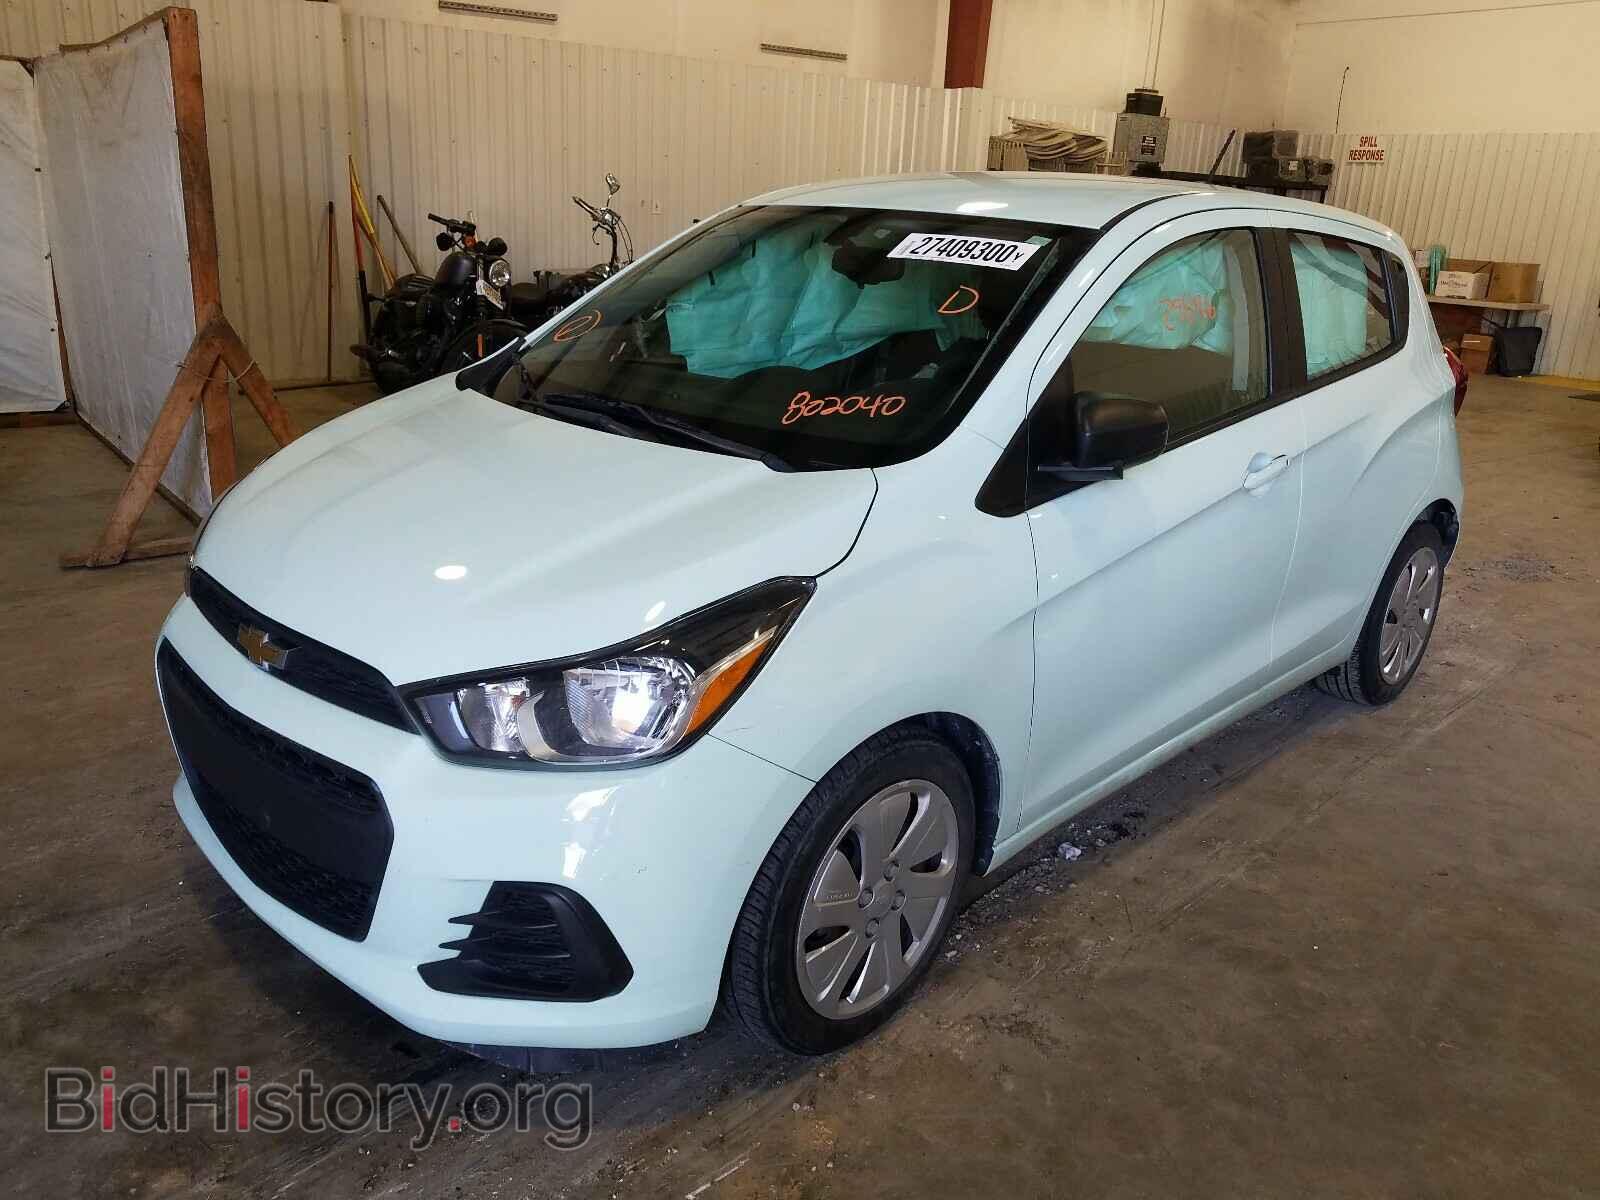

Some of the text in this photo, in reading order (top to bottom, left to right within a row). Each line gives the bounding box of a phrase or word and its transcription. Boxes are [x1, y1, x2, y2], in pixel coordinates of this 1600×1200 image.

[1360, 135, 1377, 147] SPILL
[1348, 149, 1384, 161] RESPONSE
[937, 284, 980, 314] D
[781, 391, 907, 425] 802040
